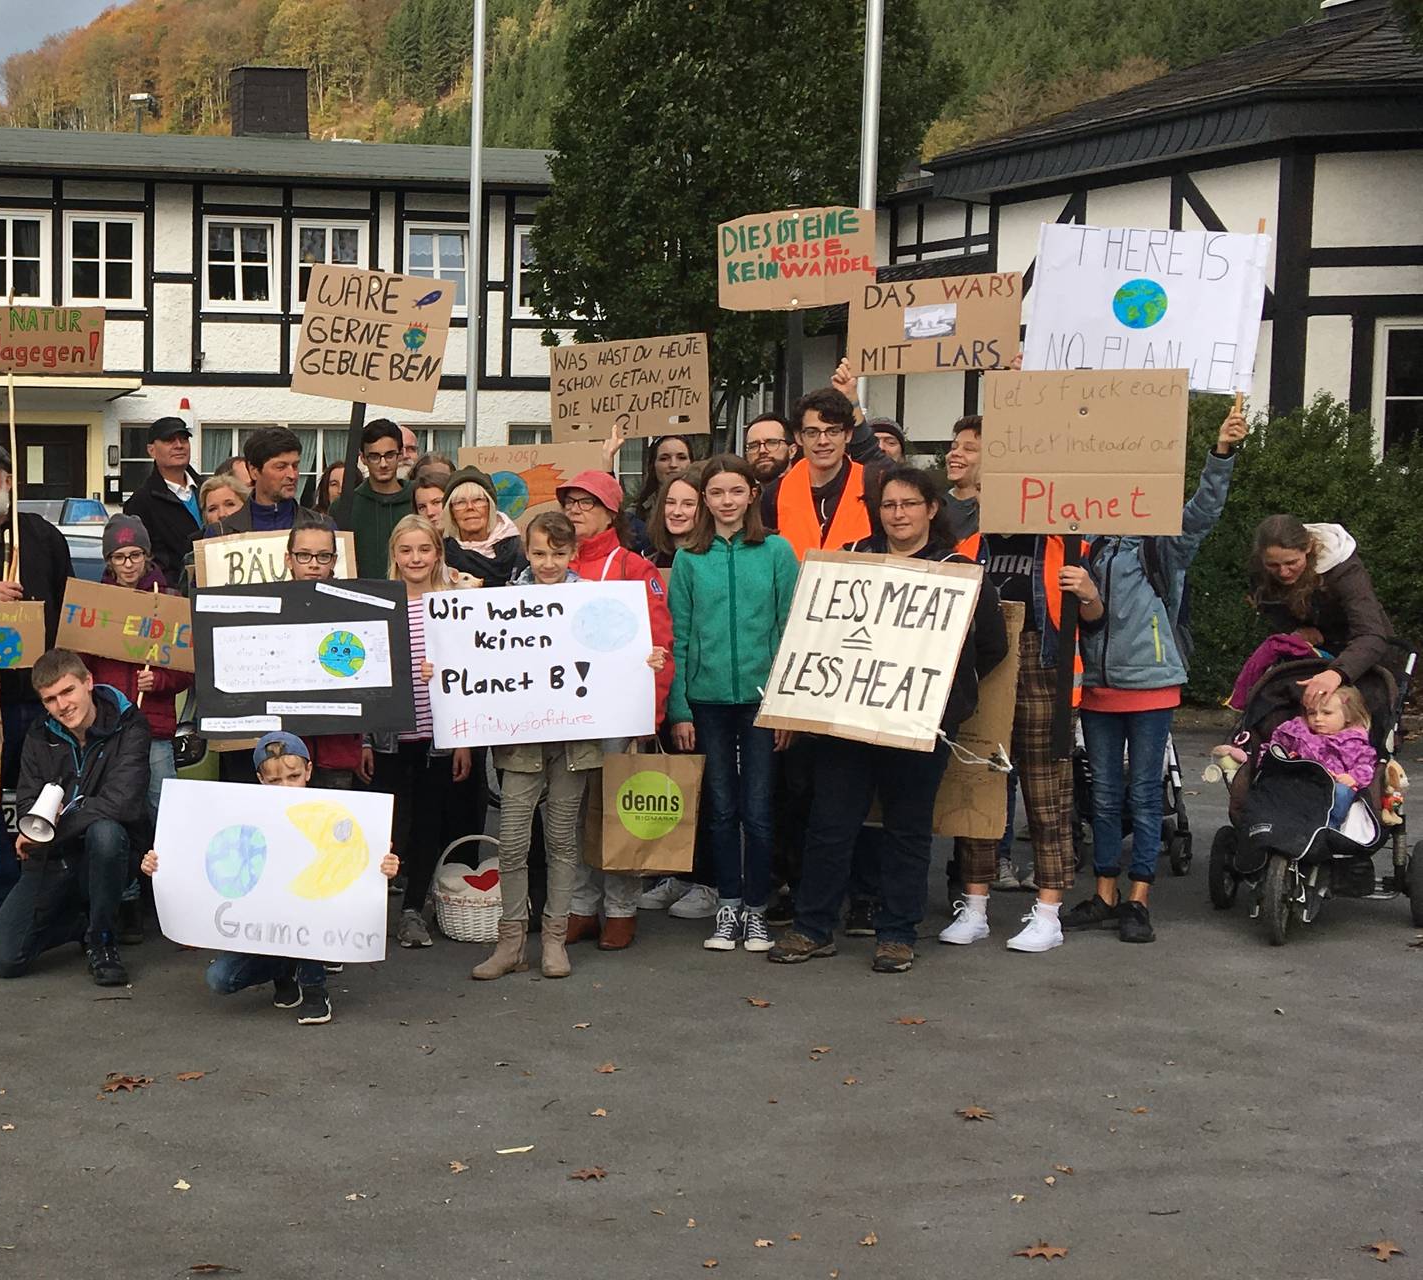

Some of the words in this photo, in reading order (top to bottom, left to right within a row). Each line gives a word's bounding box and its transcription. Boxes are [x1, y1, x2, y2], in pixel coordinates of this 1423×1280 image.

[1070, 226, 1186, 275] THERE
[1199, 232, 1230, 281] IS
[317, 274, 404, 314] WÄRE
[864, 283, 916, 310] DAS
[941, 274, 1016, 300] WAR'S
[9, 307, 82, 333] NATUR
[307, 316, 392, 349] GERNE
[554, 351, 588, 371] WAS
[598, 346, 631, 366] HAST
[633, 345, 653, 362] DU
[659, 336, 702, 359] HEUTE
[861, 344, 912, 373] MIT
[936, 340, 1002, 368] LARS
[557, 374, 603, 396] SCHON
[609, 368, 664, 389] GETAN,
[668, 366, 691, 381] UM
[1129, 373, 1184, 398] each
[558, 401, 580, 419] DIE
[591, 393, 623, 414] WELT
[628, 394, 650, 412] ZU
[651, 385, 702, 409] RETTEN
[987, 421, 1063, 458] other
[1020, 476, 1152, 524] Planet
[224, 547, 288, 586] BÄU
[65, 603, 112, 628] TUT
[428, 597, 474, 620] Wir
[487, 599, 565, 621] haben
[806, 578, 872, 623] LESS
[874, 581, 965, 631] MEAT
[123, 640, 172, 664] WAS
[441, 668, 534, 696] Planet
[777, 652, 843, 698] LESS
[845, 658, 942, 712] HEAT
[214, 901, 310, 946] Game
[322, 927, 380, 949] over
